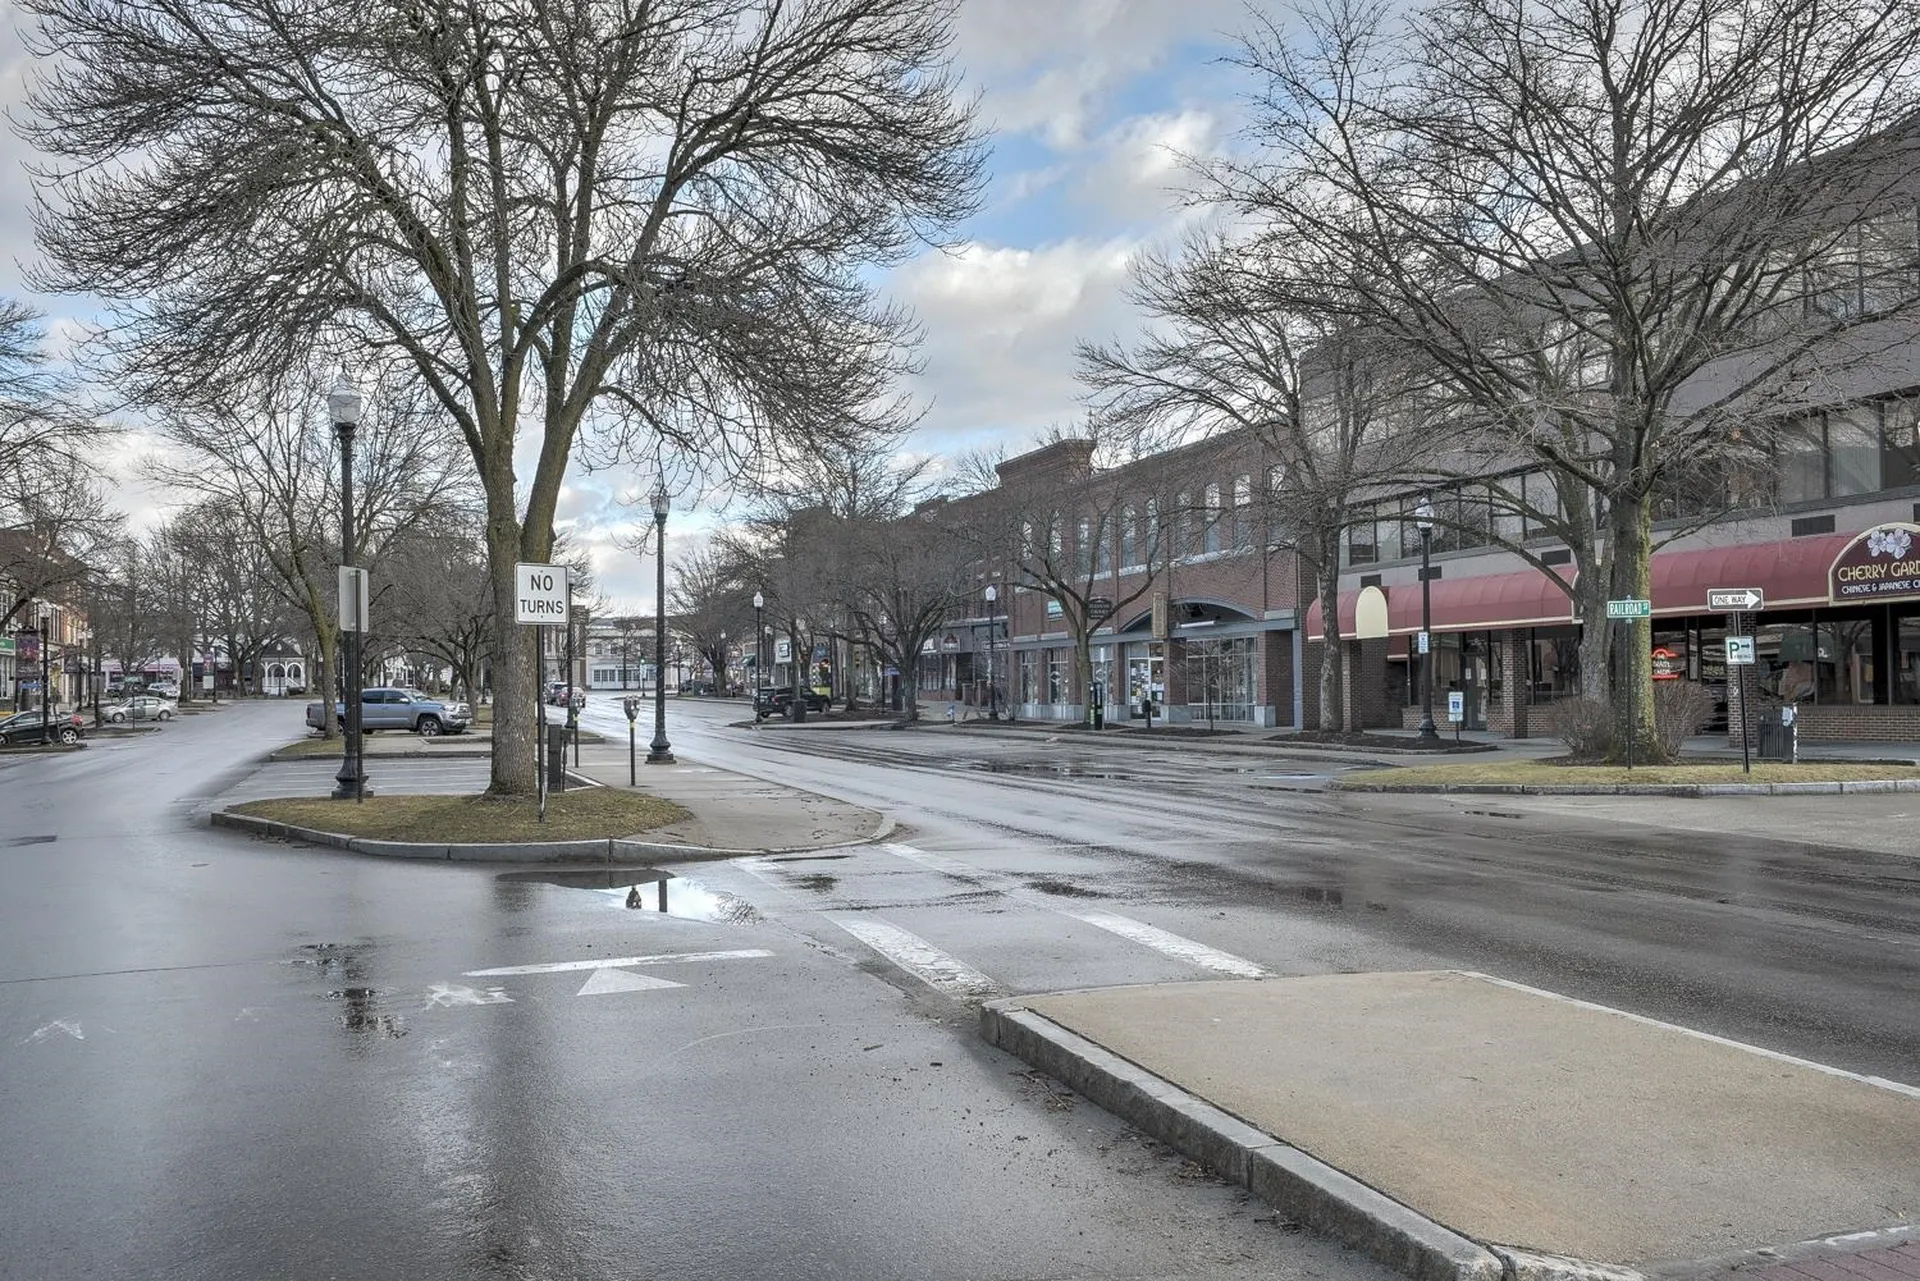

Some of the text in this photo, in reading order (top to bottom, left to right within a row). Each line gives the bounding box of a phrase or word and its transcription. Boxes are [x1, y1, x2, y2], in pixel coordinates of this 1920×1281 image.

[1838, 563, 1887, 581] CHERRY
[530, 574, 553, 591] NO
[1842, 583, 1871, 594] CHINESE
[1878, 580, 1911, 591] JAPANESE
[520, 599, 564, 614] TURNS
[1714, 595, 1746, 605] ONE WAY
[1610, 603, 1642, 615] RAILROAD
